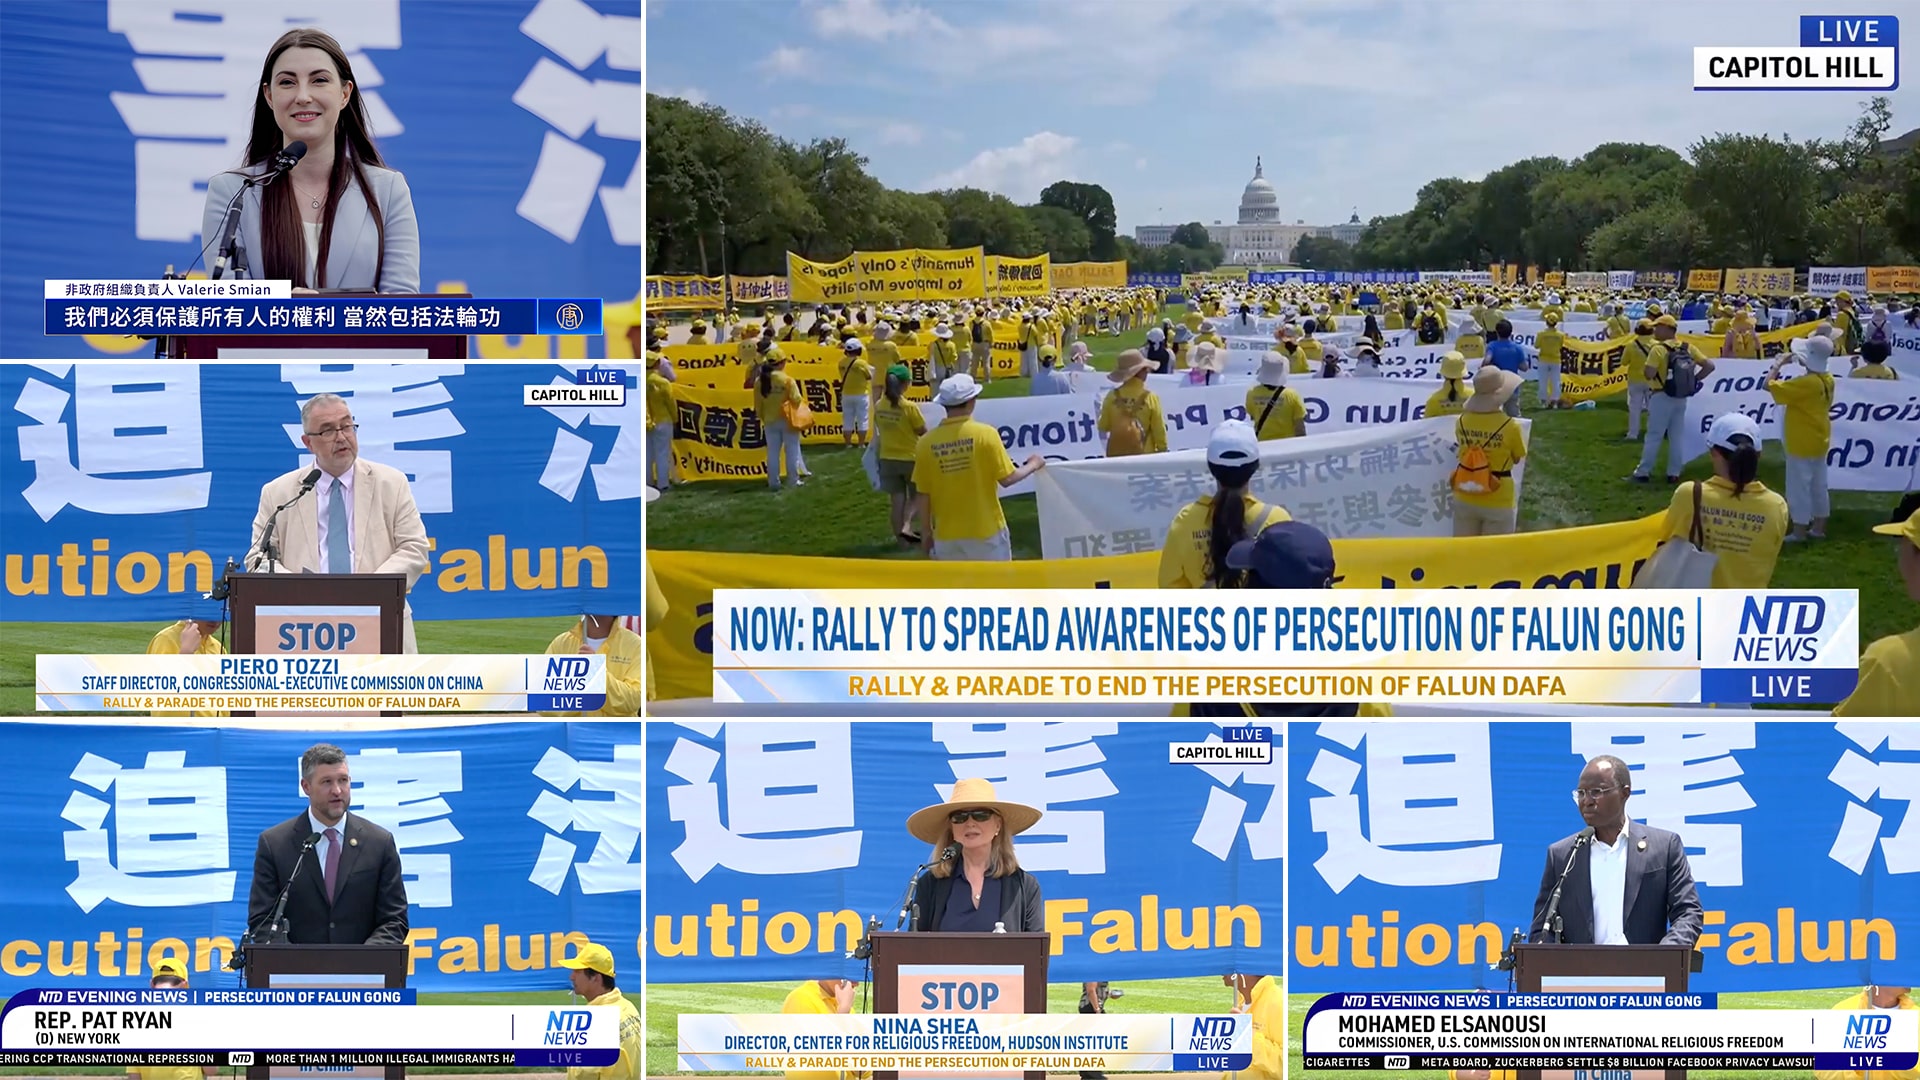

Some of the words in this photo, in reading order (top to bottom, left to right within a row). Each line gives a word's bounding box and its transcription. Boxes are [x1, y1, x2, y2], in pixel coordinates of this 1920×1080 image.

[278, 623, 355, 650] STOP
[1044, 894, 1262, 957] Falun
[922, 982, 999, 1010] STOP
